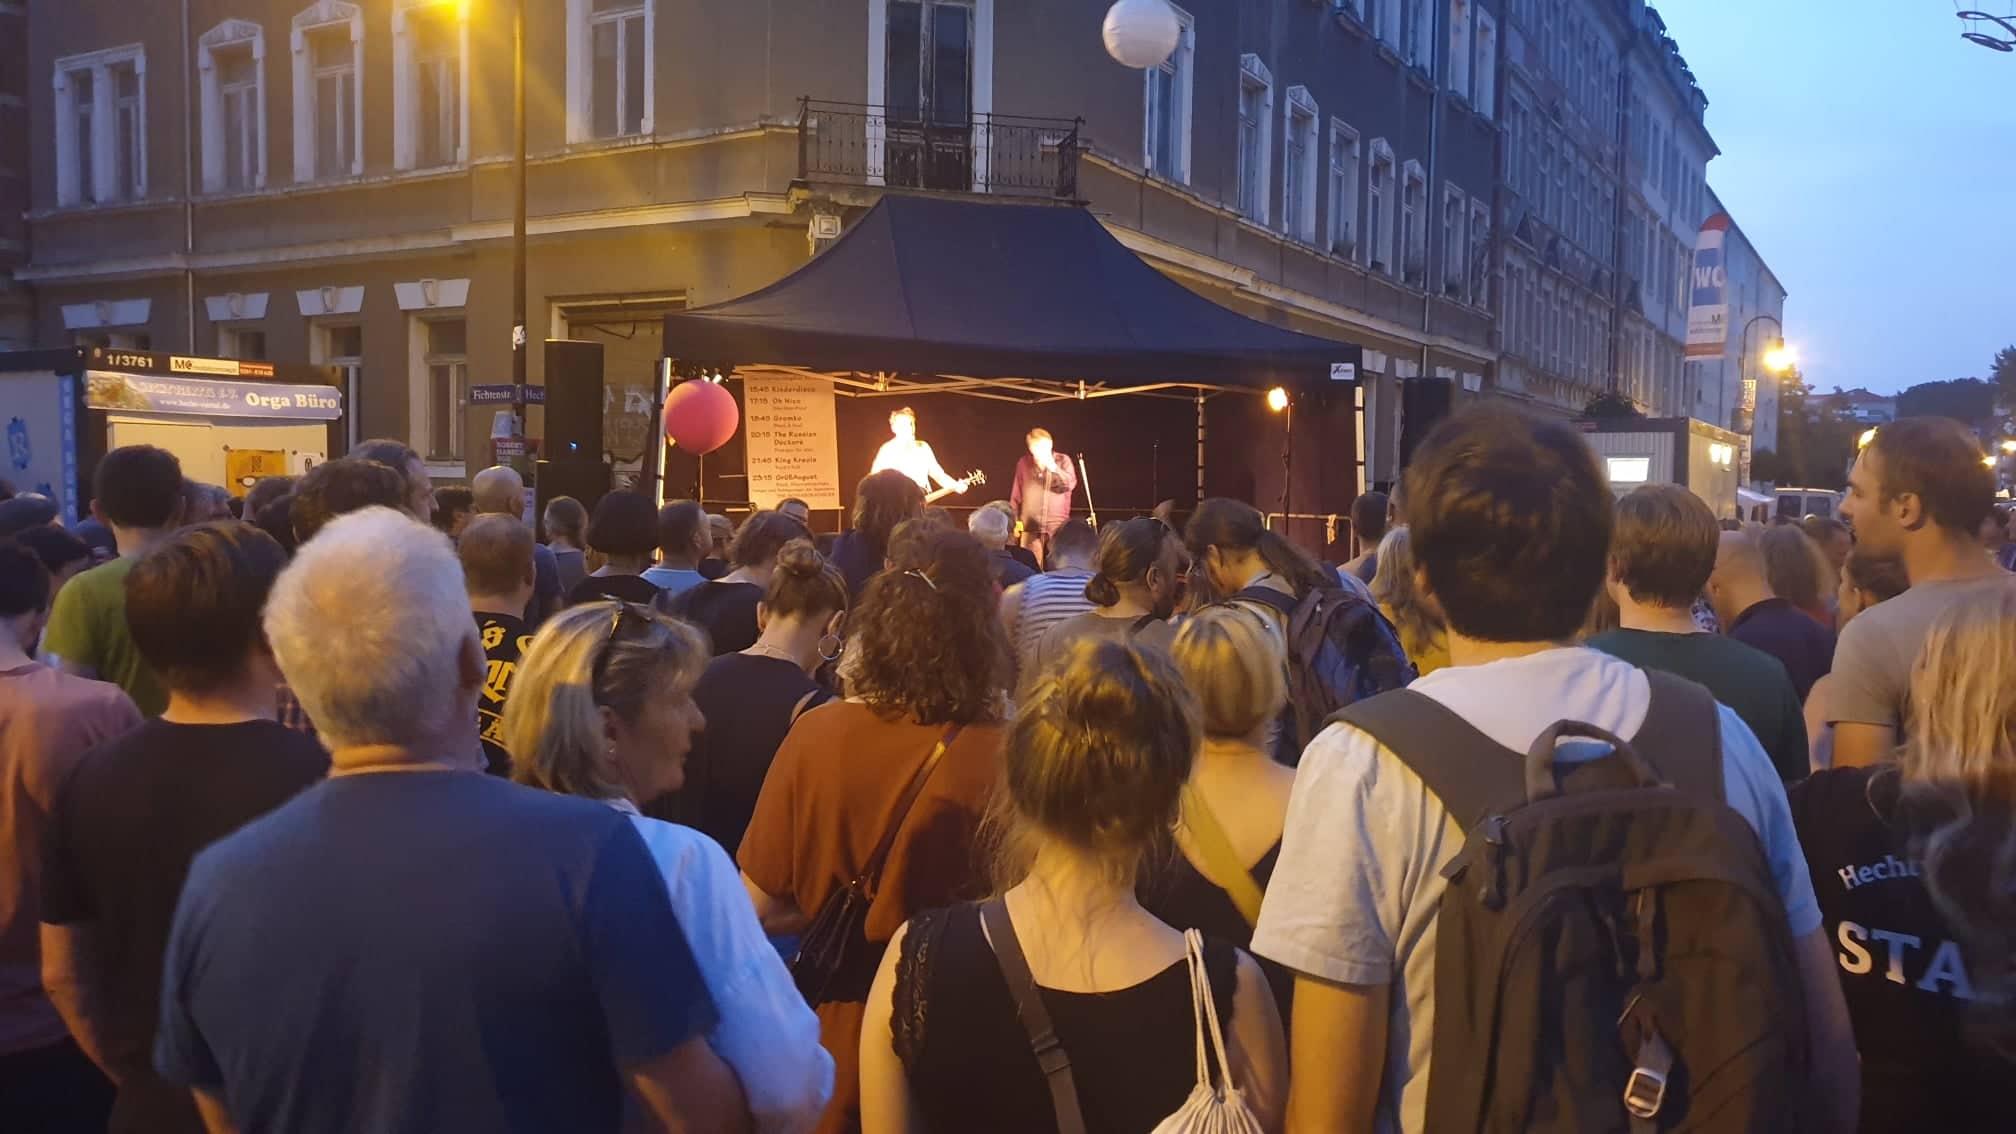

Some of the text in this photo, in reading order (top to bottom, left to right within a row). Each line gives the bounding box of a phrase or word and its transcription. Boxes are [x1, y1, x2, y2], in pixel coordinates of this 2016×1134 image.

[107, 355, 152, 368] 1/3761
[245, 392, 337, 408] Orga Büro
[1838, 920, 1978, 1000] STA
